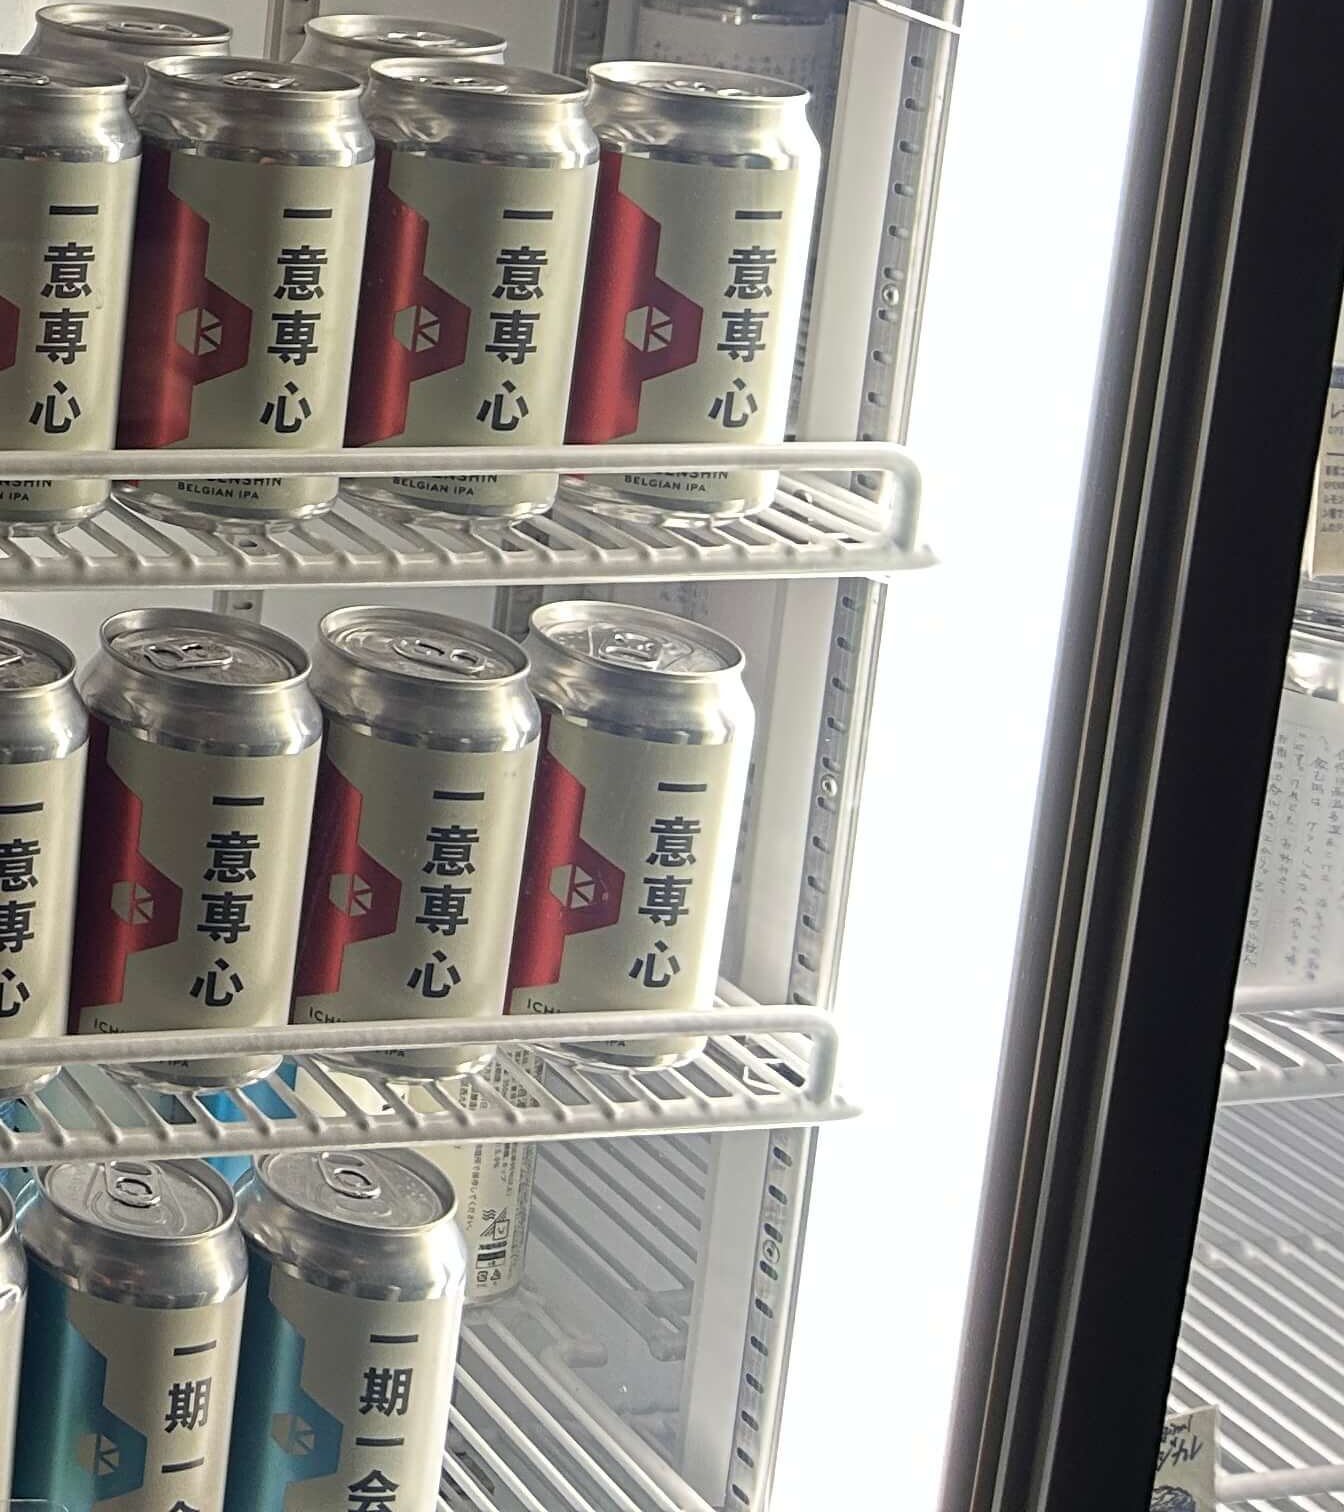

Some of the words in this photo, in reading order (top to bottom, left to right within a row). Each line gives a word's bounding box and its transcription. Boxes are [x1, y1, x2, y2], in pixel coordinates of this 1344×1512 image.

[29, 204, 99, 434] 一意専心
[259, 207, 332, 434] 一意専心
[476, 207, 553, 432] 一意専心
[708, 208, 784, 429] 一意専心
[8, 490, 30, 502] IPA
[177, 481, 234, 498] BELGIAN
[238, 489, 259, 500] IPA
[393, 476, 449, 492] BELGIAN
[453, 484, 474, 496] IPA
[624, 475, 681, 490] BELGIAN
[685, 481, 707, 492] IPA
[190, 795, 265, 1010] 一意専心
[407, 789, 486, 1000] 一意専心
[628, 781, 708, 990] 一意専心
